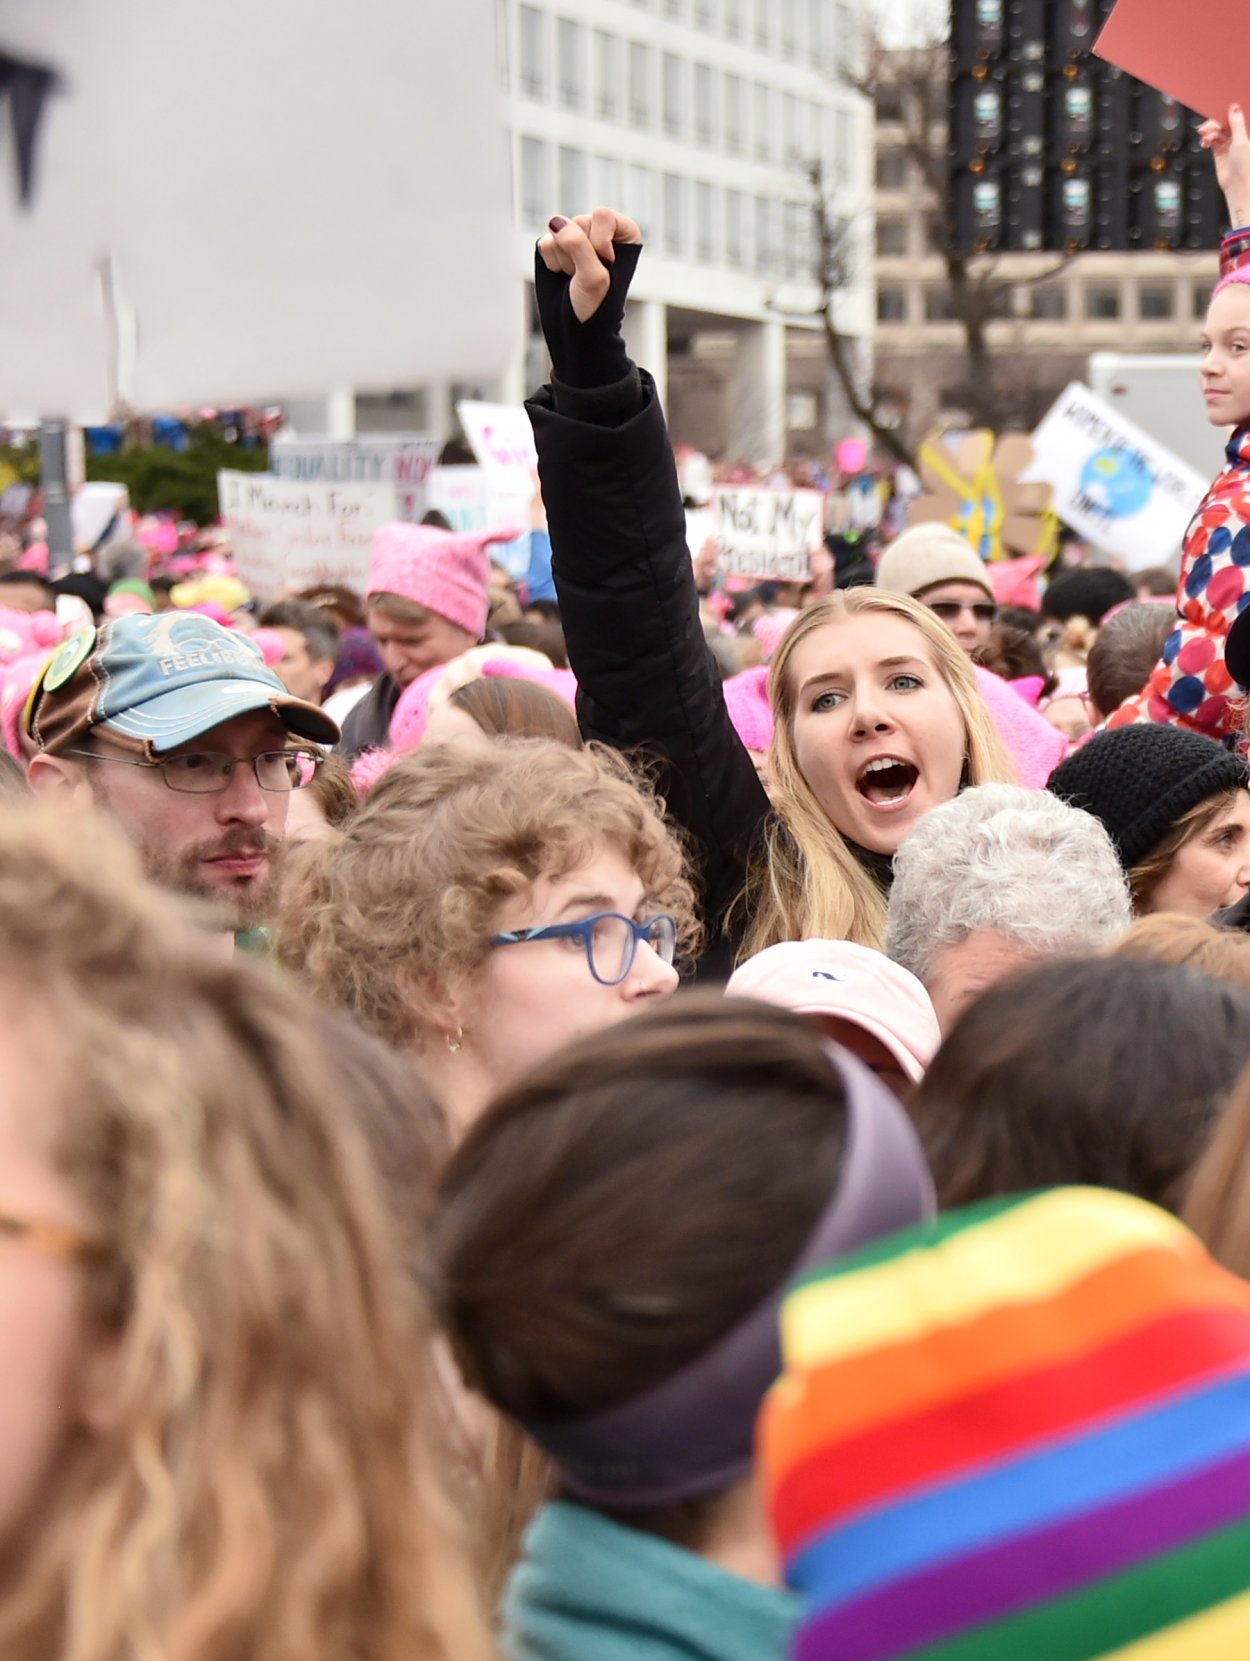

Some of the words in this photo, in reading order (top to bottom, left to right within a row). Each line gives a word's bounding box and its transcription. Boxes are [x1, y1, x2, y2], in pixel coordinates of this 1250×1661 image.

[719, 493, 762, 536] Not
[768, 493, 819, 556] My
[160, 651, 215, 676] FEEL
